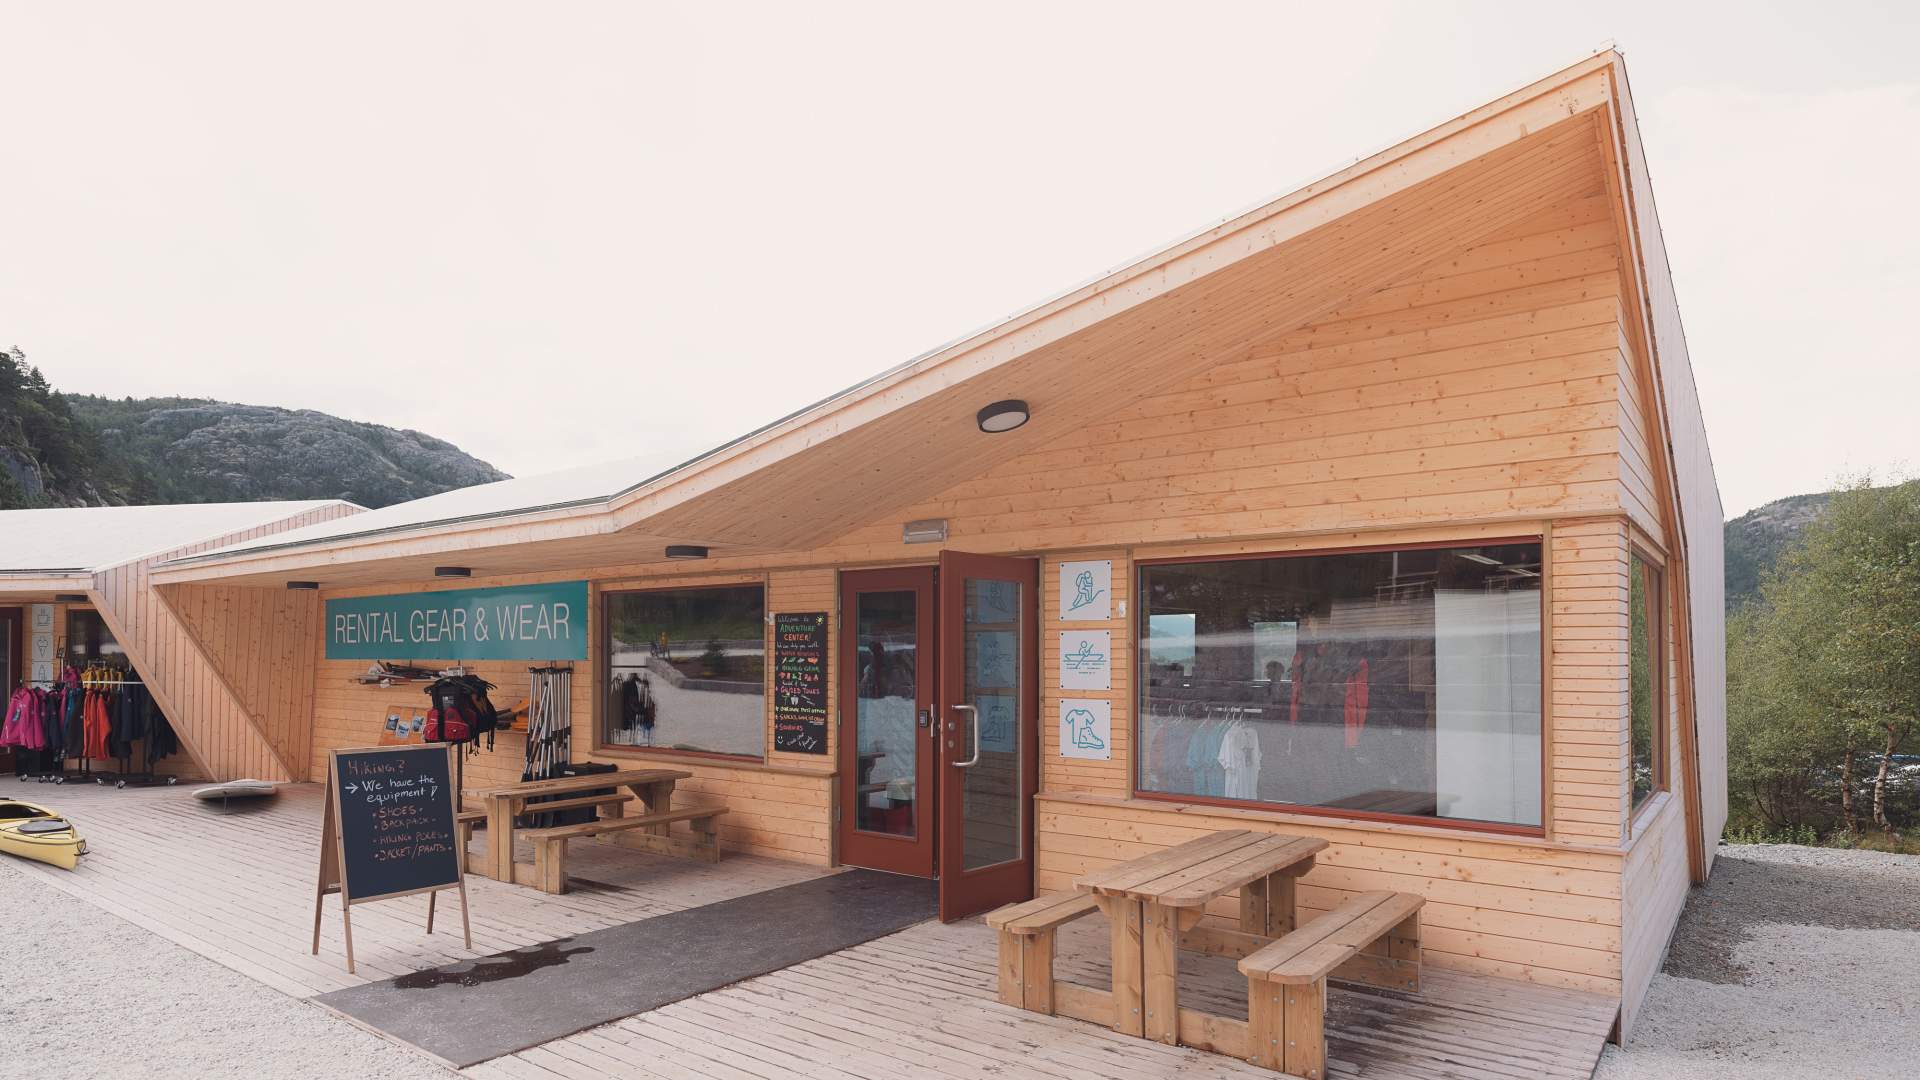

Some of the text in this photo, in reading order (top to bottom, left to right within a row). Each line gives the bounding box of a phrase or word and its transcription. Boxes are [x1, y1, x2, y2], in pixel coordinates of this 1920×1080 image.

[335, 602, 570, 644] RENTAL GEAR & WEAR
[362, 774, 436, 792] We have the
[378, 805, 417, 818] SHOES
